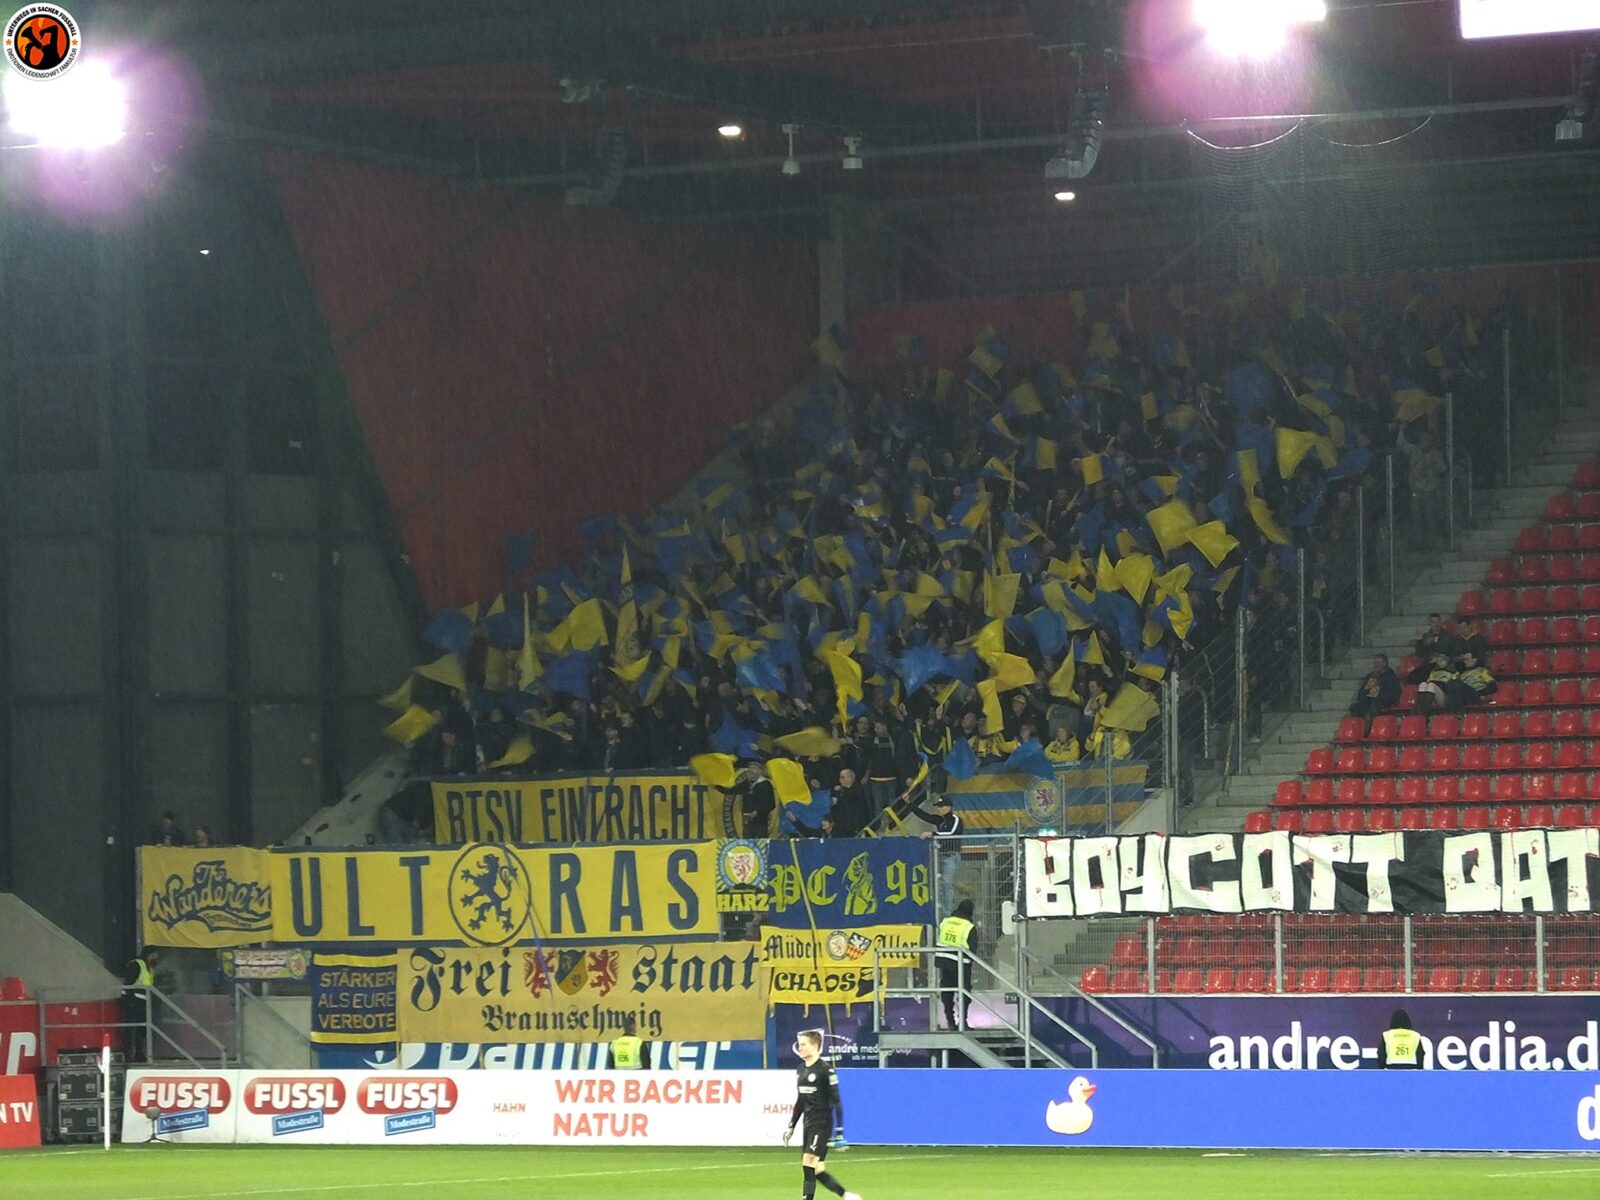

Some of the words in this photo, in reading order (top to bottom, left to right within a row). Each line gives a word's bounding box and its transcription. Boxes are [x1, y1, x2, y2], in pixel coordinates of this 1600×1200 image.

[446, 789, 522, 842] BTSV
[540, 783, 708, 842] EINTRACHT
[1025, 831, 1404, 915] BOYCOTT
[717, 893, 769, 912] HARZ
[320, 968, 395, 989] STÄRKER
[410, 946, 512, 1012] Frei
[626, 945, 760, 993] staat
[774, 971, 857, 993] CHAOS
[318, 993, 350, 1009] ALS
[352, 991, 395, 1009] EURE
[318, 1012, 396, 1030] VERBOTE
[1395, 1046, 1409, 1056] 261
[140, 1082, 224, 1109] FUSSL
[254, 1083, 339, 1110] FUSSL
[366, 1083, 451, 1110] FUSSL
[555, 1079, 616, 1104] WIR
[624, 1079, 743, 1104] BACKEN
[10, 1102, 33, 1123] TV
[493, 1102, 526, 1114] HAHN
[553, 1112, 649, 1137] NATUR
